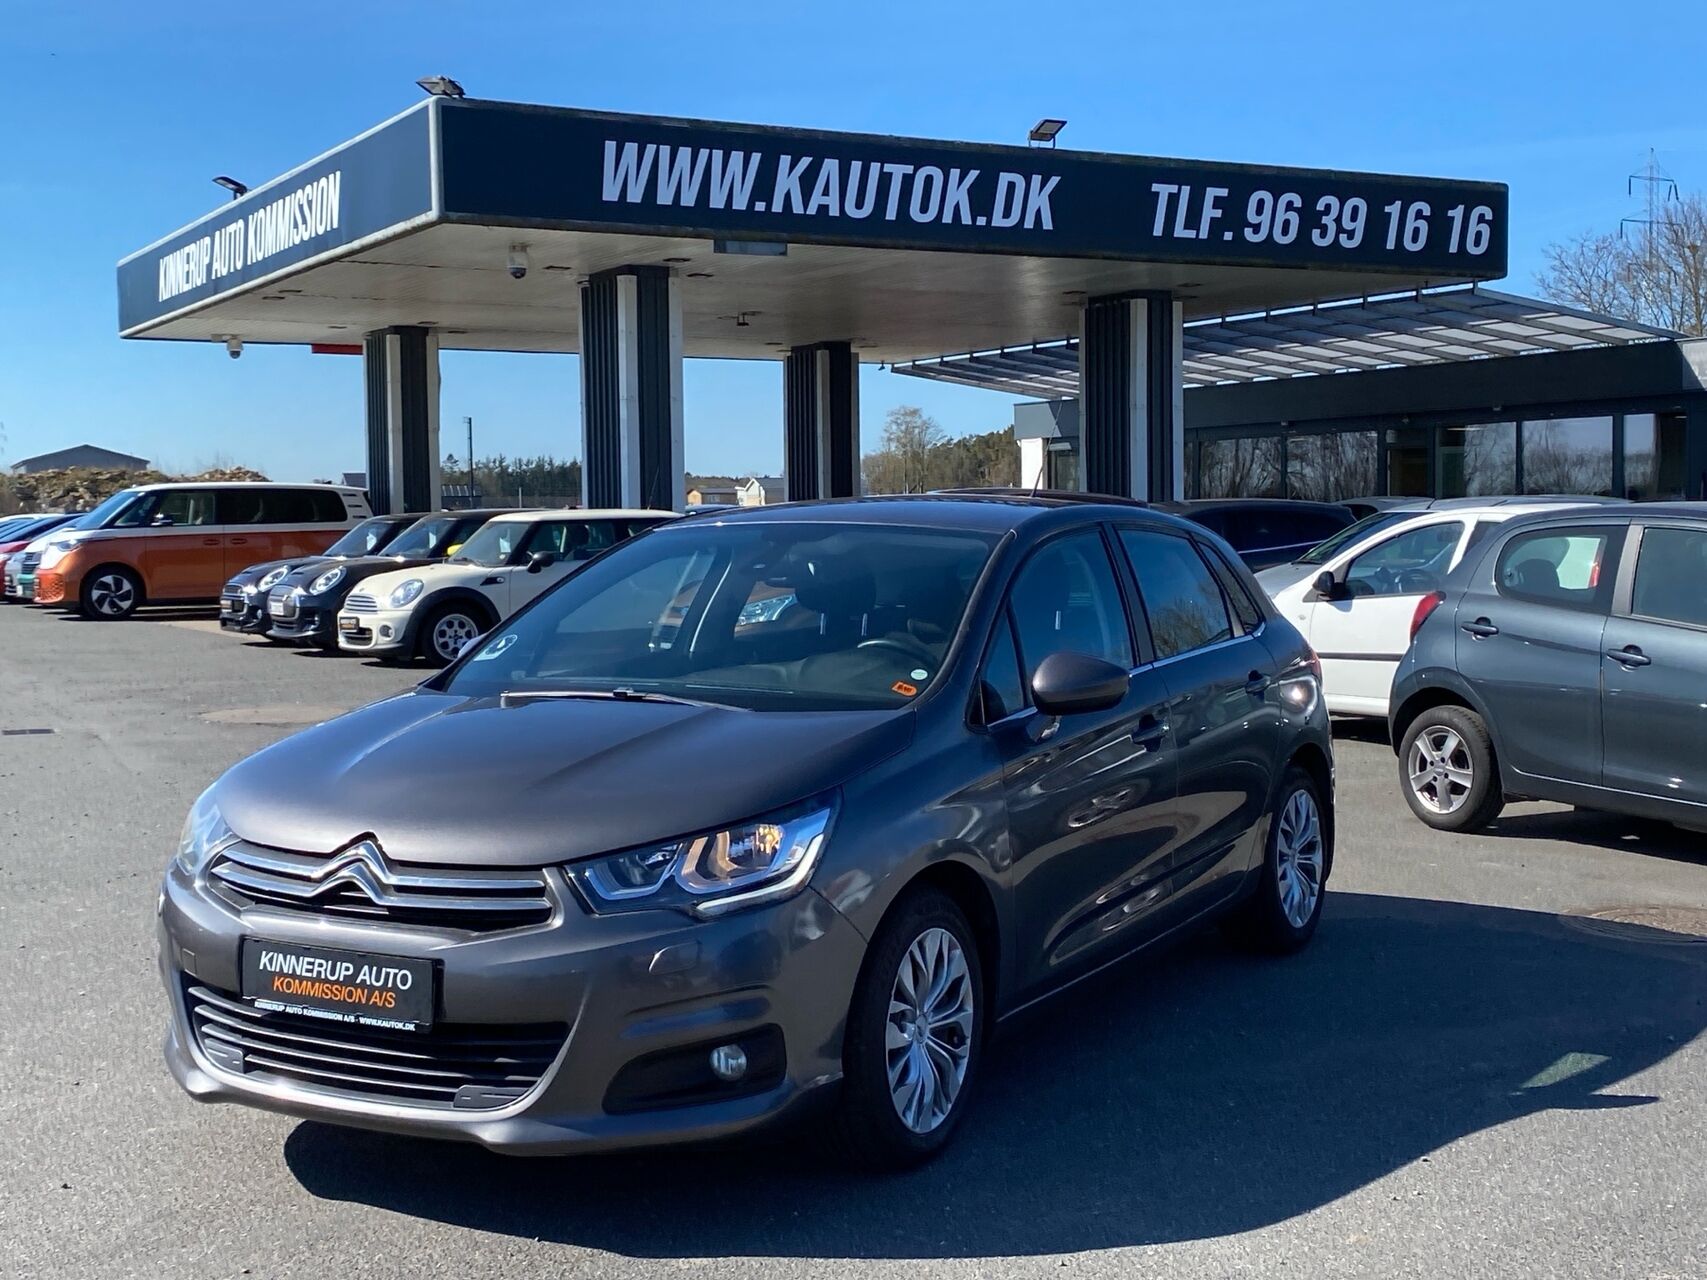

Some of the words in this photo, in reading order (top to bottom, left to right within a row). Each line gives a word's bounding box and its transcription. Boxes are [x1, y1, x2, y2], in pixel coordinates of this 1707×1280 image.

[602, 140, 1061, 231] WWW.KAUTOK.DK
[158, 236, 211, 302] KINNERUP
[211, 219, 245, 280] AUTO
[247, 170, 341, 265] KOMMISSION
[1151, 183, 1233, 241] TLF.
[1244, 190, 1302, 245] 96
[1311, 195, 1367, 249] 39
[1384, 200, 1431, 252] 16
[1447, 204, 1493, 255] 16
[259, 951, 354, 982] KINNERUP
[356, 964, 412, 990] AUTO
[273, 976, 368, 1004] KOMMISSION
[369, 991, 396, 1008] A/S
[285, 1005, 302, 1015] AUTO
